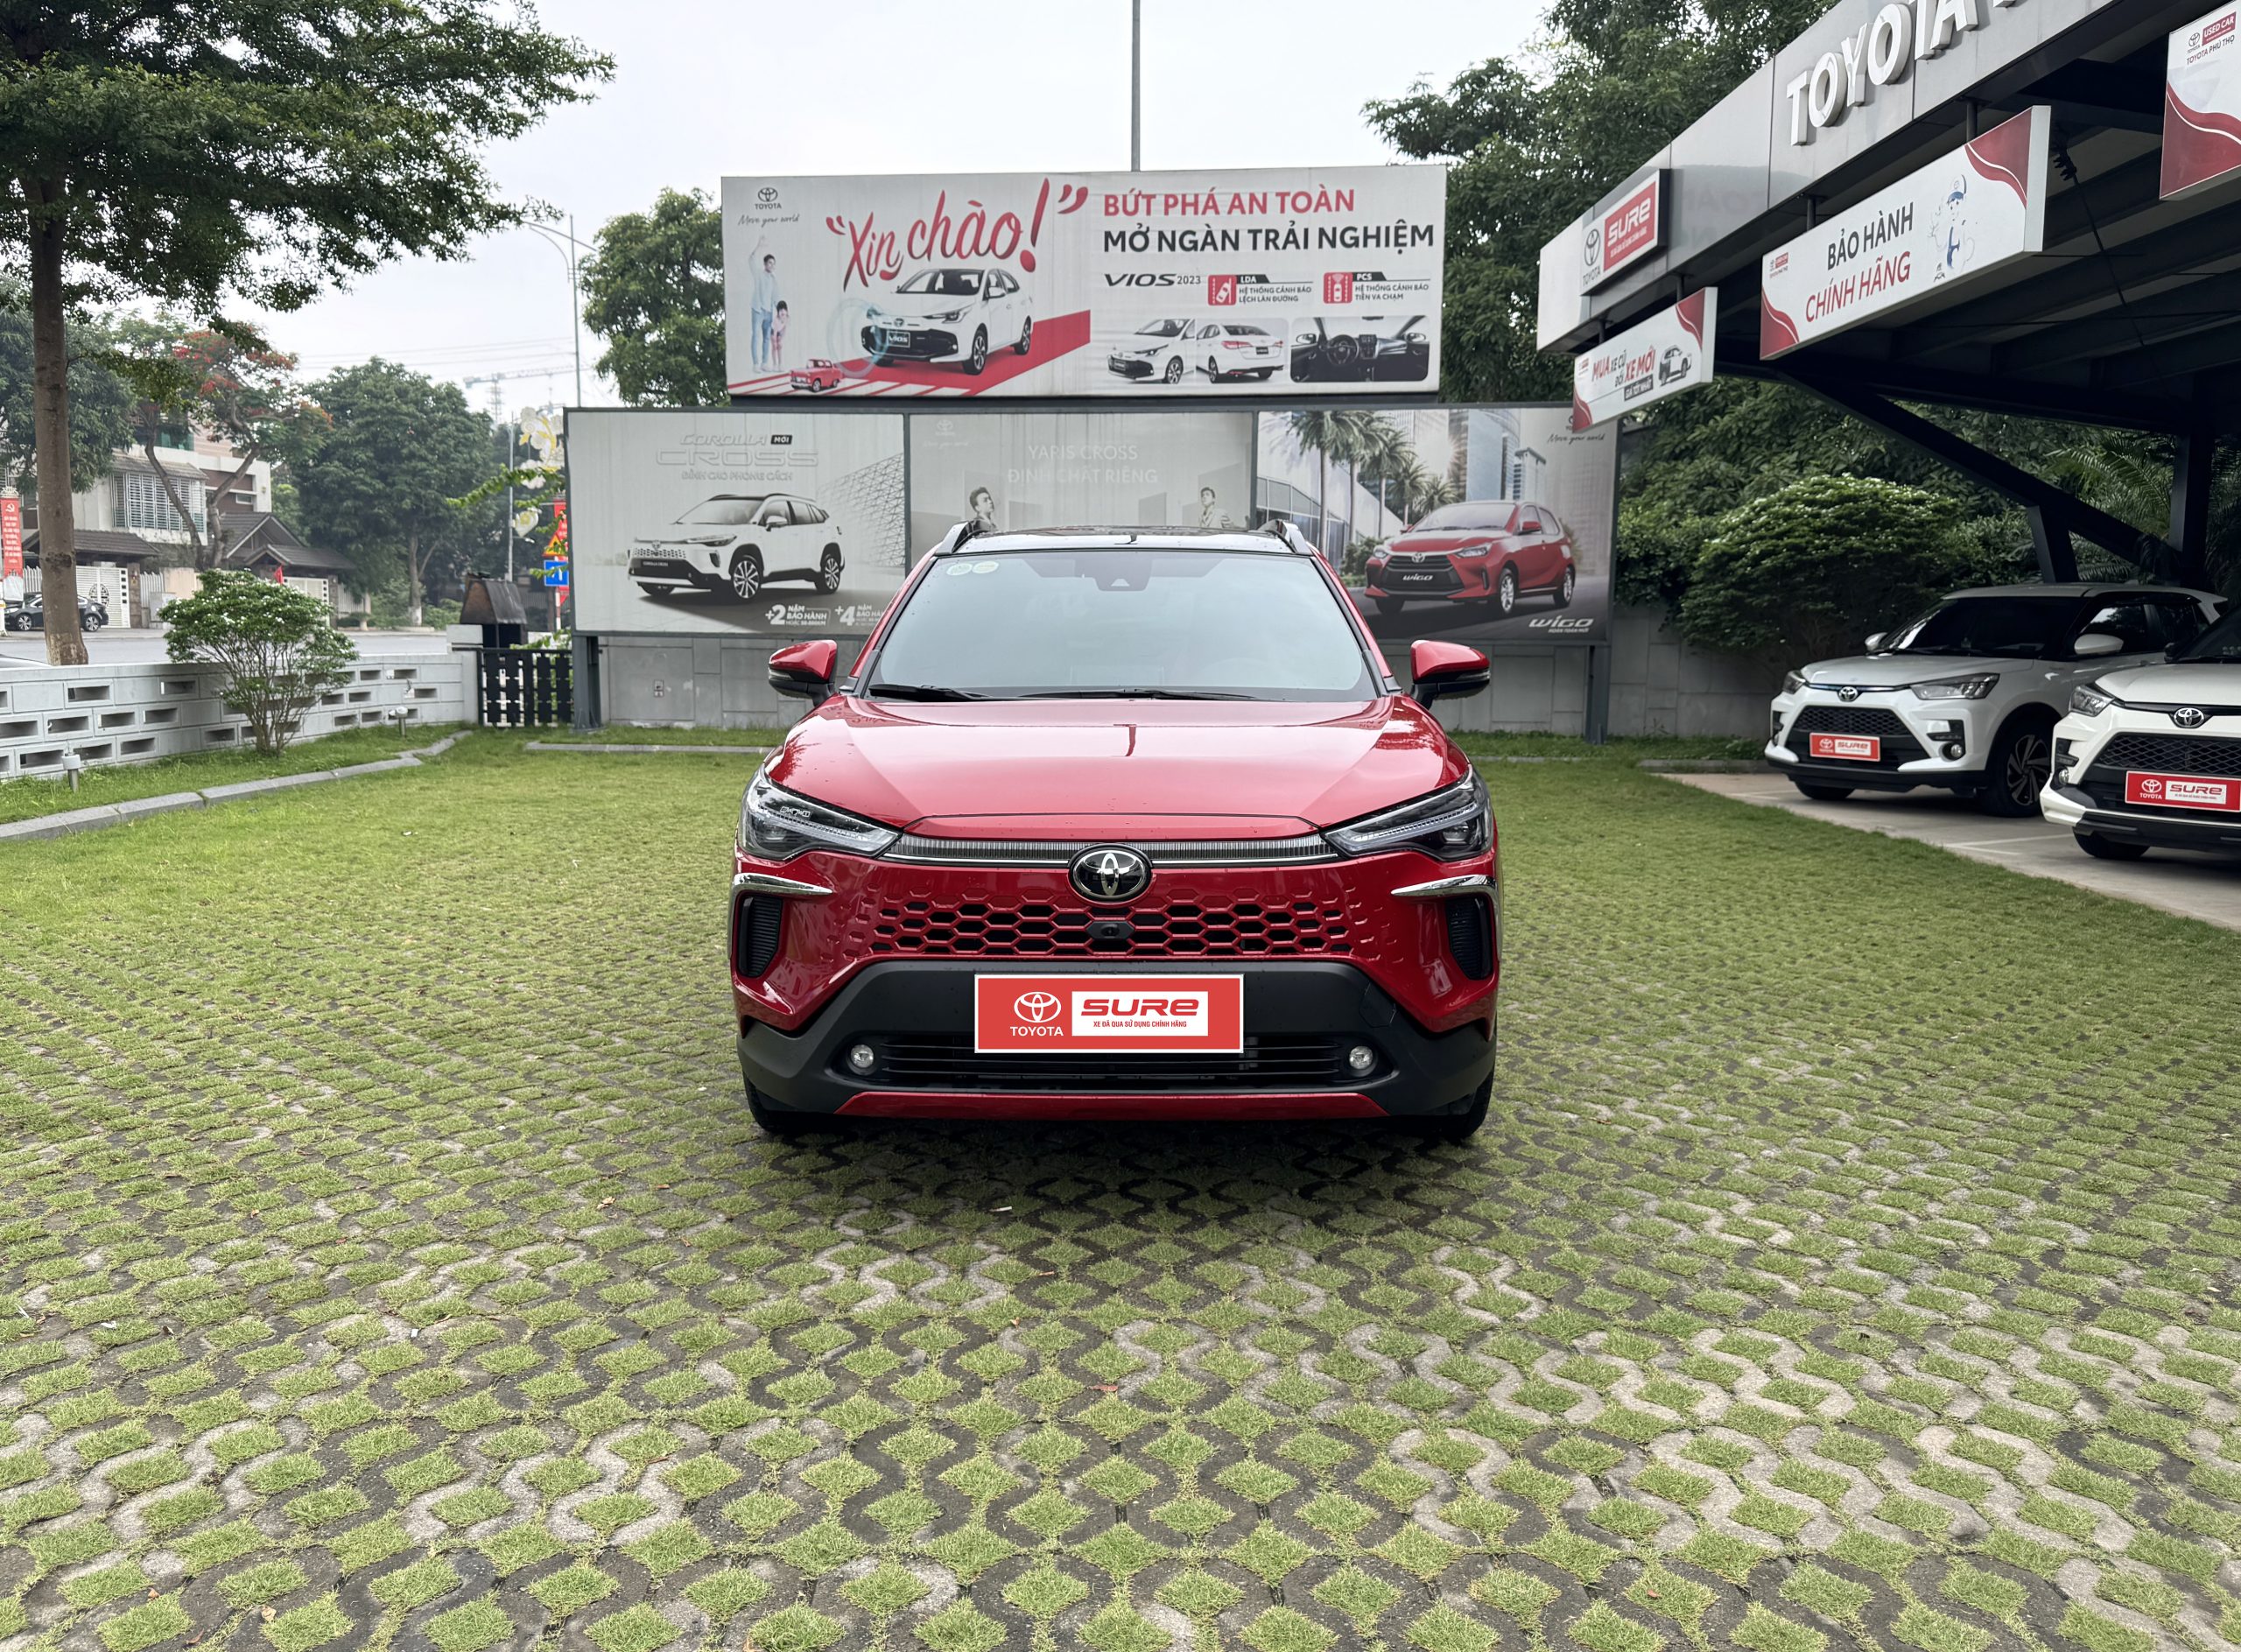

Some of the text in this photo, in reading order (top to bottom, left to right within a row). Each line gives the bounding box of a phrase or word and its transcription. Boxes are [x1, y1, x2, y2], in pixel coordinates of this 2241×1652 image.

[2203, 23, 2220, 38] USED
[2221, 16, 2235, 28] CAR
[2187, 34, 2235, 65] TOYOTA PHÚ THỌ
[1787, 0, 1979, 146] TOYOTA
[1104, 183, 1354, 217] BỨT PHÁ AN TOÀN
[1104, 218, 1434, 255] MỞ NGÀN TRẢI NGHIỆM
[1828, 201, 1914, 271] BẢO HÀNH
[1104, 273, 1201, 287] VIOS 2023
[1806, 250, 1911, 322] CHÍNH HÃNG
[1591, 354, 1612, 382] MUA
[1611, 357, 1619, 372] XE
[1625, 358, 1636, 382] XE
[1636, 345, 1656, 375] MỚI
[657, 449, 819, 467] CROSS
[1029, 445, 1138, 460] YARIS CROSS
[1105, 465, 1158, 482] RIÊNG
[765, 604, 786, 625] +2
[835, 605, 856, 626] +4
[1009, 1026, 1064, 1037] TOYOTA
[1124, 1019, 1134, 1028] SỬ
